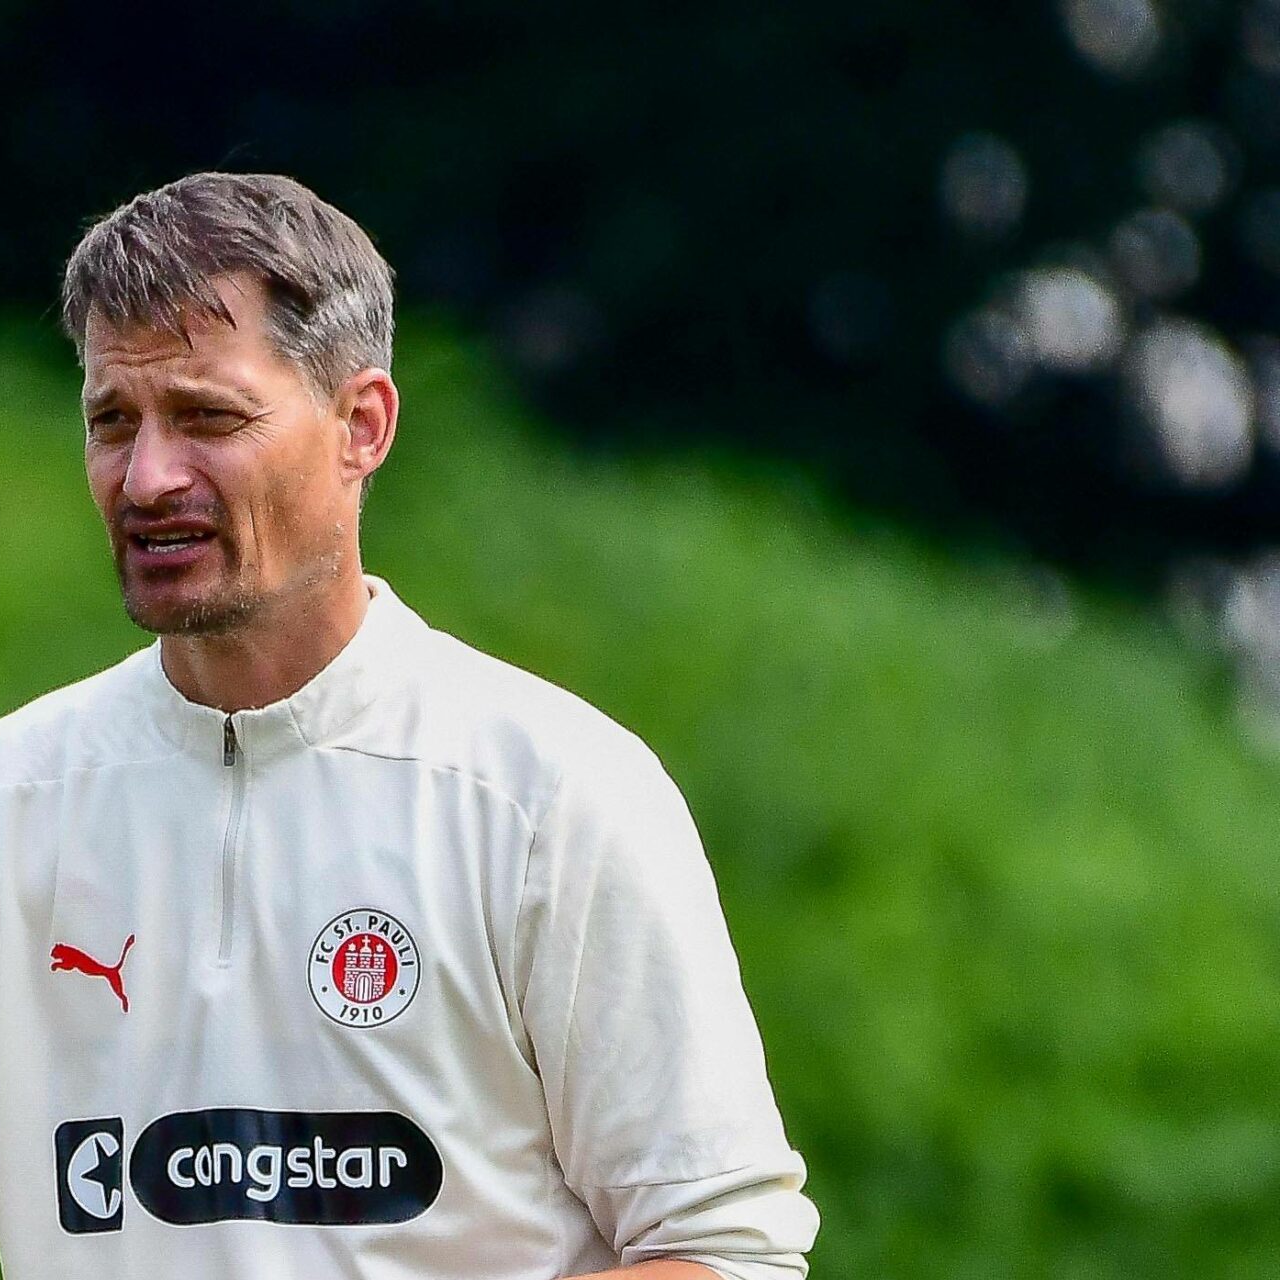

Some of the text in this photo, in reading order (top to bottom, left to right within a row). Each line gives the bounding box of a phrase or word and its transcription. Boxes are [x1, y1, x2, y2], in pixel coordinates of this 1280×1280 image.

[315, 915, 414, 966] FC ST. PAULI
[339, 1004, 383, 1022] 1910
[167, 1135, 407, 1202] congstar
